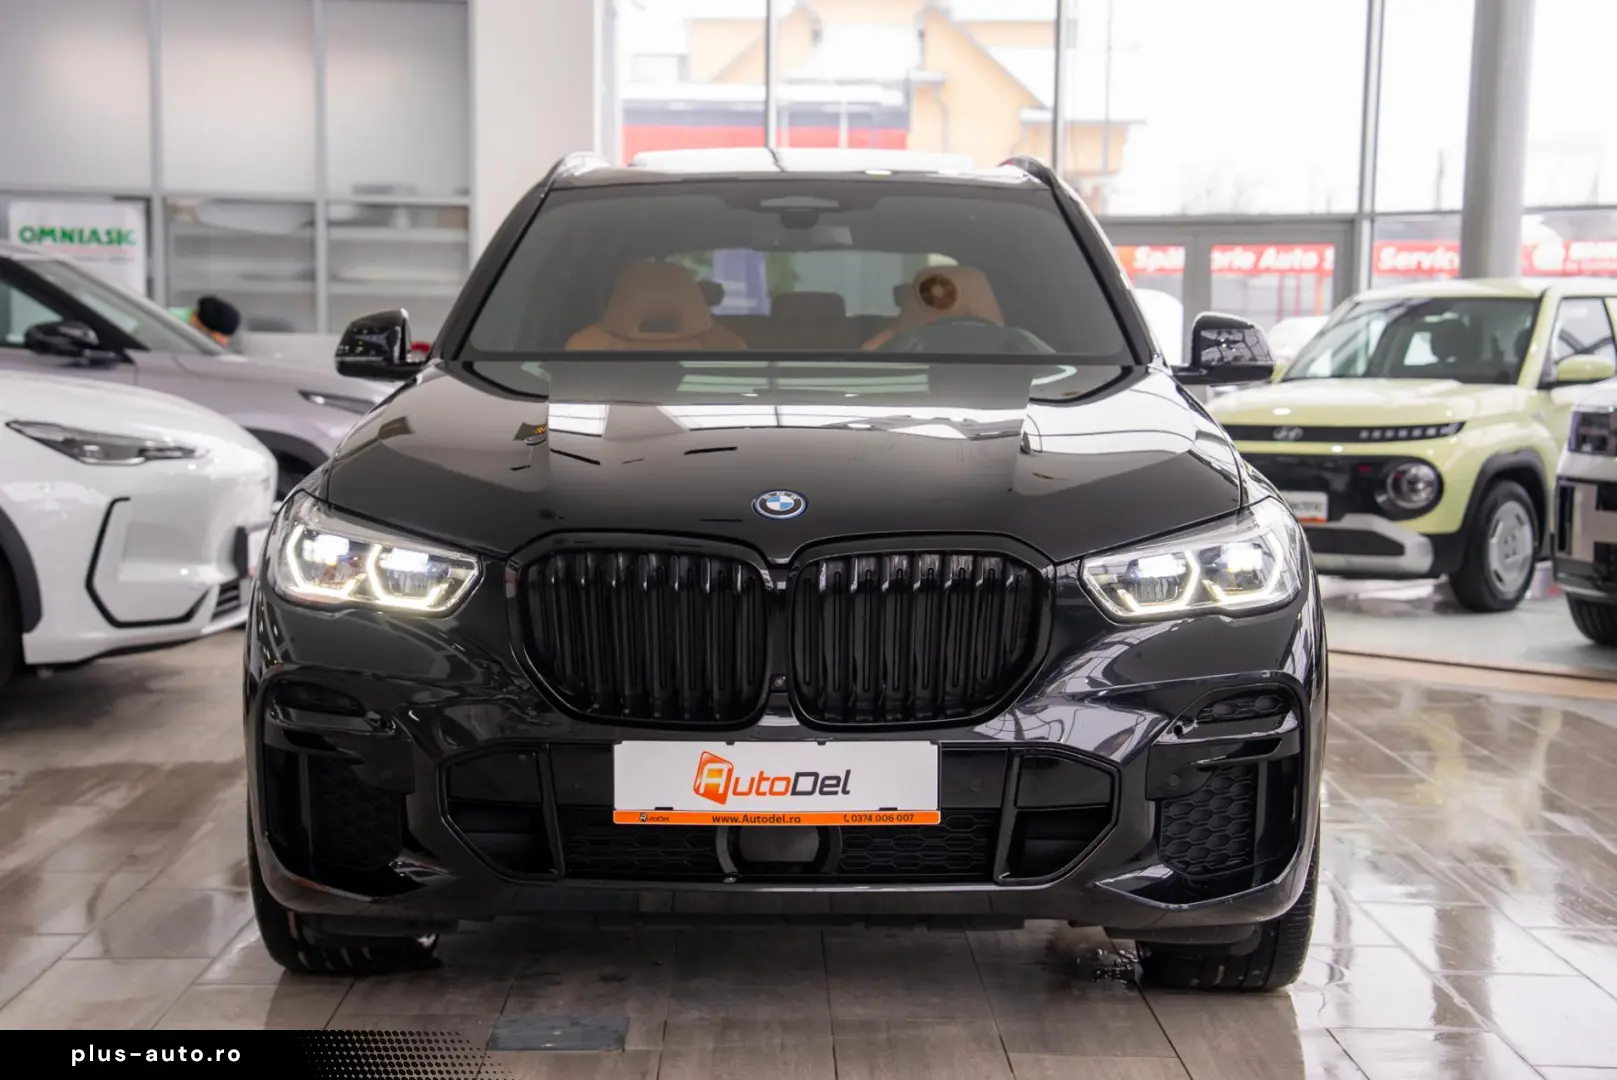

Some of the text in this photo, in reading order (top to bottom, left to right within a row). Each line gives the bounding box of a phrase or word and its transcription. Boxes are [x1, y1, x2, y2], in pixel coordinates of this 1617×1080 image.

[1258, 248, 1318, 269] Auto
[698, 759, 852, 797] AutoDel
[711, 813, 801, 824] www.Autodel.ro
[851, 813, 914, 823] 0374 006 007
